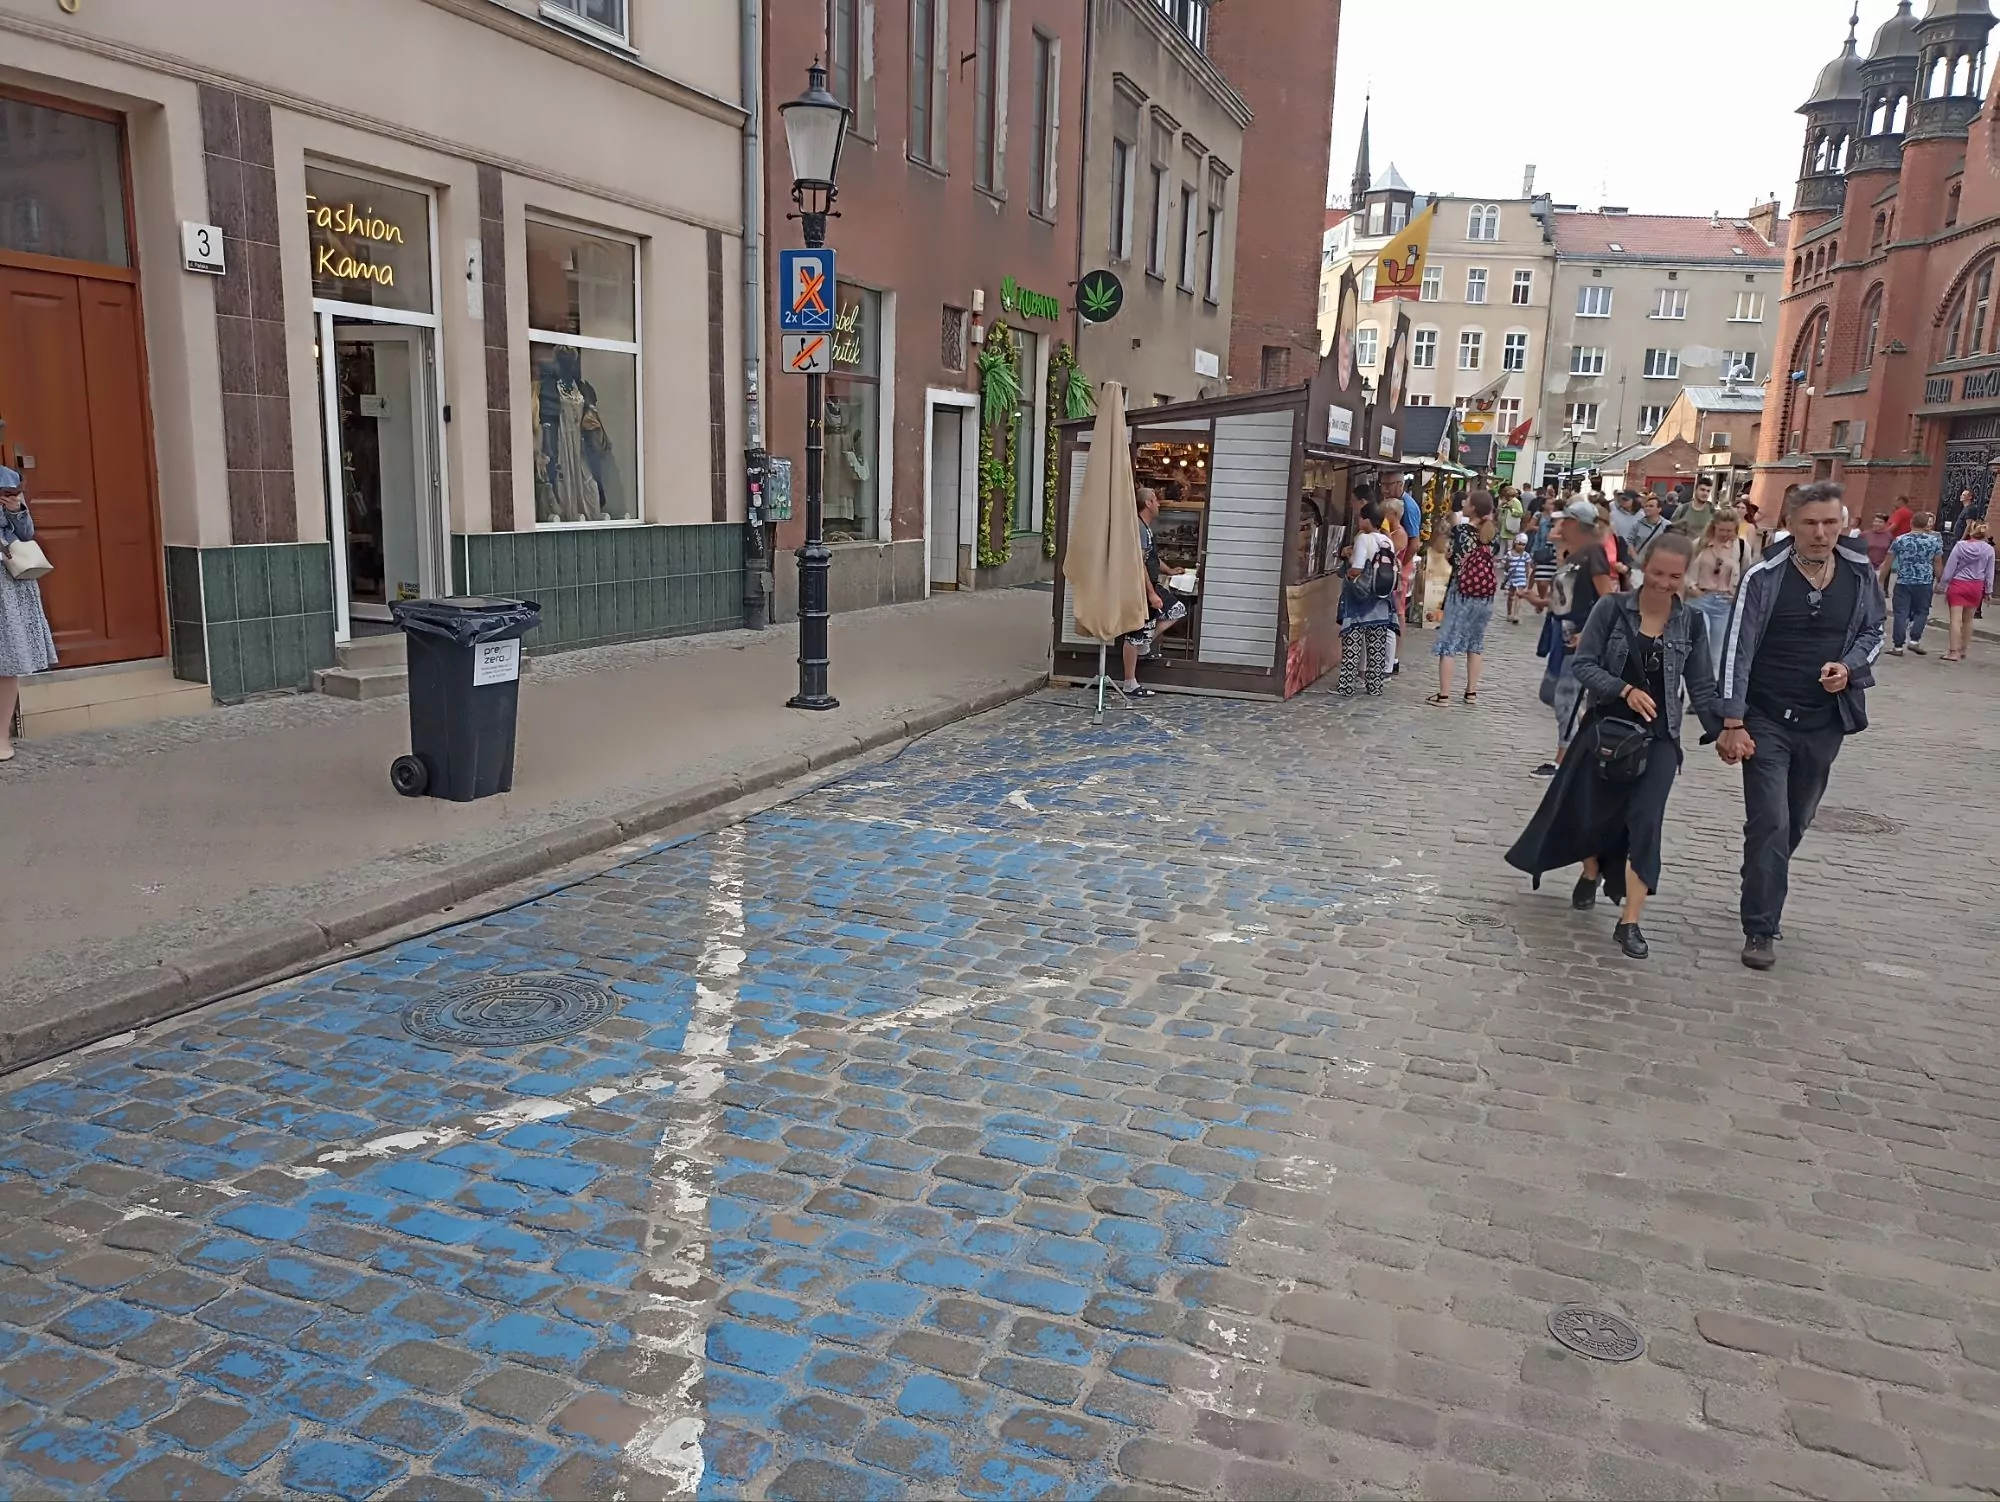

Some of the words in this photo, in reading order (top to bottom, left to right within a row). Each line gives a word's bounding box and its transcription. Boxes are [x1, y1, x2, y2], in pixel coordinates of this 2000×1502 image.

[197, 229, 211, 257] 3
[319, 245, 393, 286] Kama
[792, 256, 823, 309] P
[784, 311, 798, 324] 2x
[484, 646, 500, 656] pre
[484, 655, 505, 664] zero
